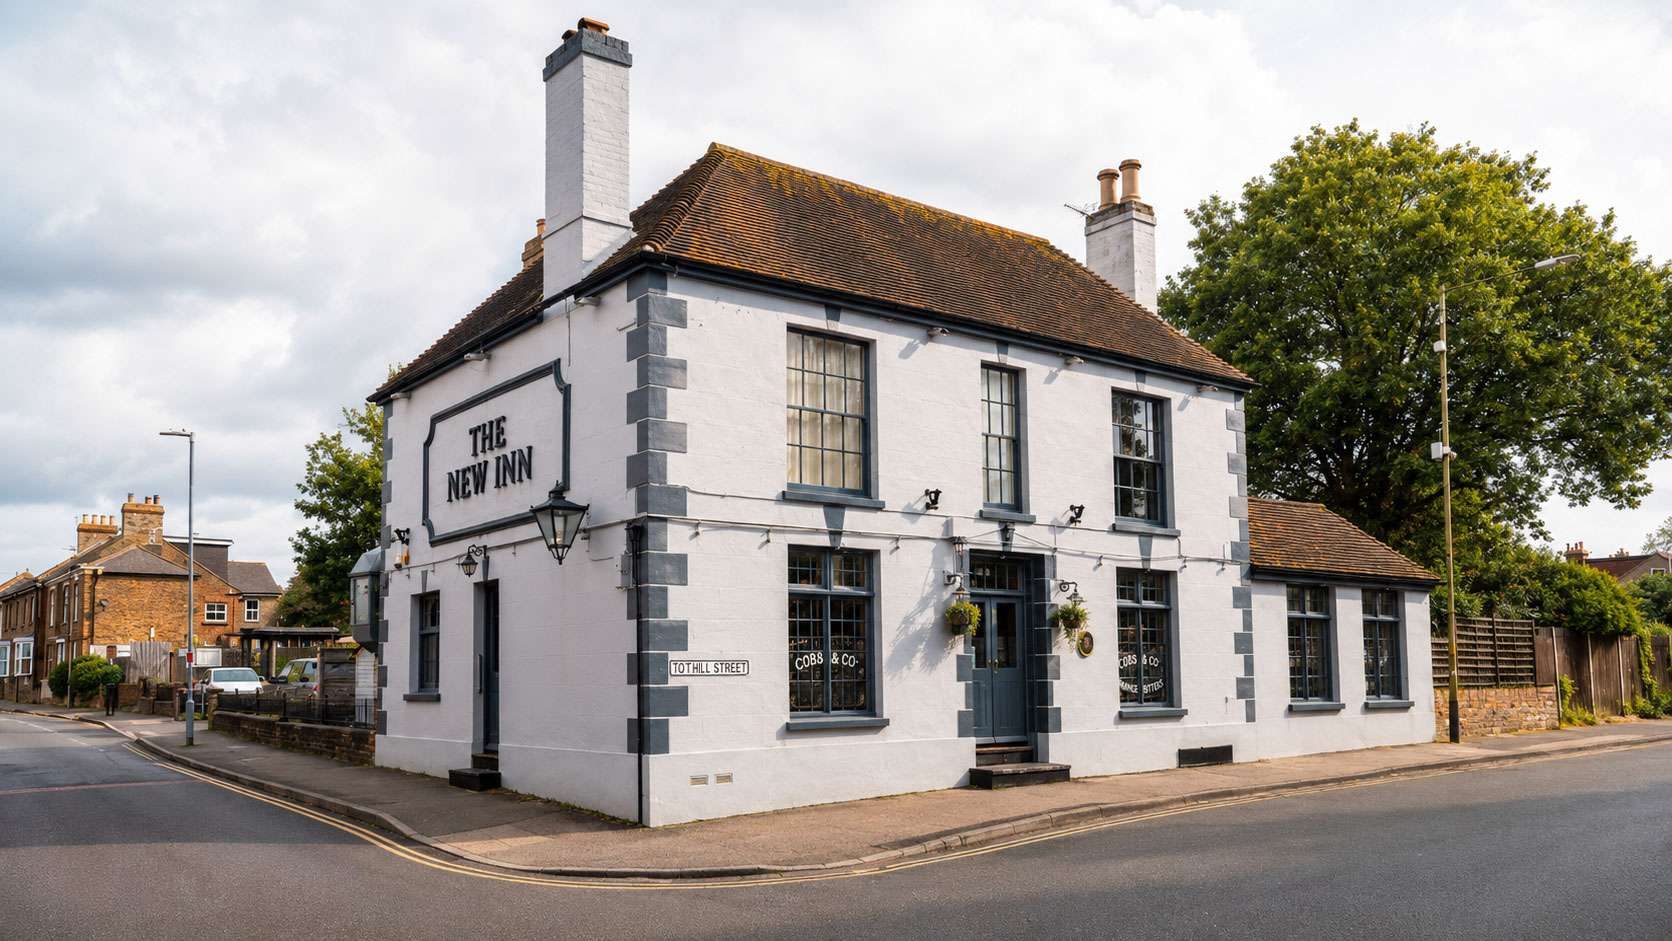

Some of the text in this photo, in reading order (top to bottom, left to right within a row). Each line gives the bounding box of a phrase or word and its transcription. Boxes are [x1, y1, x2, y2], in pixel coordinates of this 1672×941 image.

[469, 415, 507, 457] THE
[447, 445, 534, 503] NEW INN
[672, 662, 747, 674] TOTHILL STREET
[831, 652, 839, 665] &
